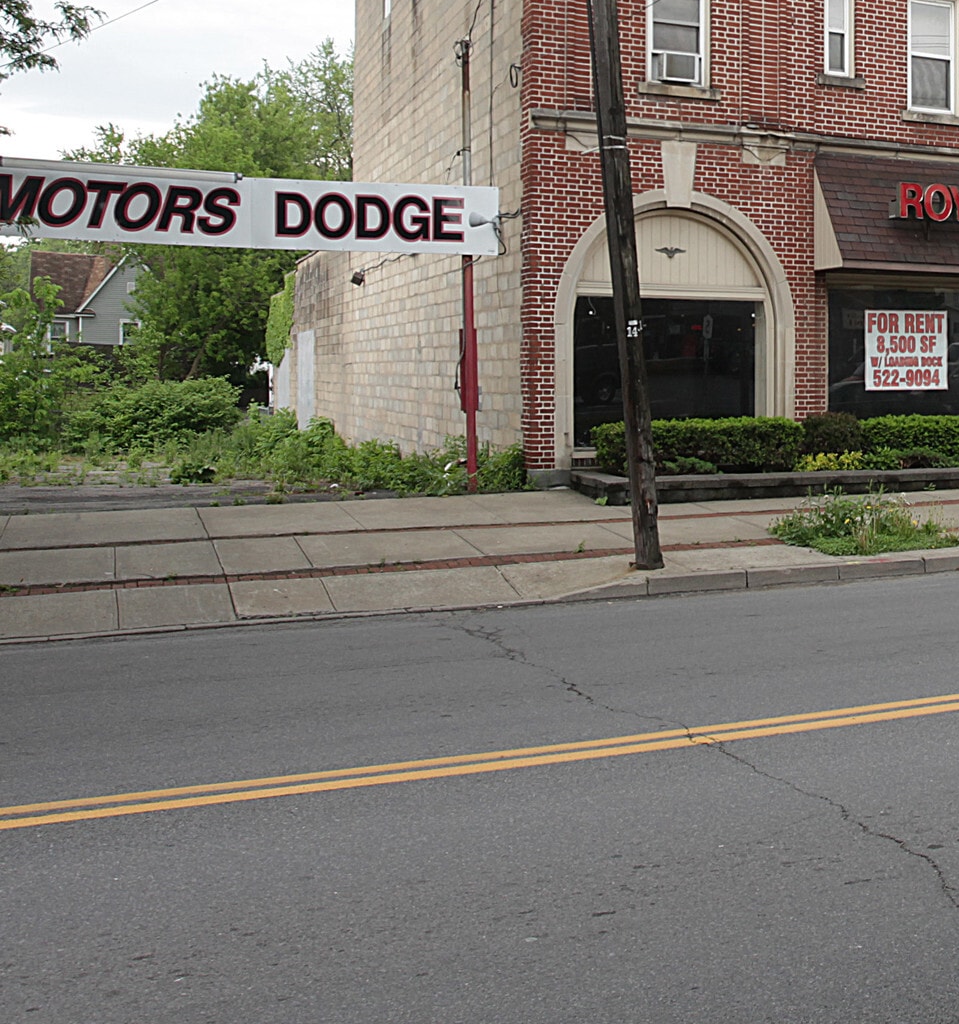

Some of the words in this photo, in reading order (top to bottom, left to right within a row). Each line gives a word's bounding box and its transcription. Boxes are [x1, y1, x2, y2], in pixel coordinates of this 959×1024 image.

[0, 173, 241, 236] MOTORS
[274, 190, 465, 243] DODGE
[626, 326, 638, 338] 14
[867, 312, 899, 333] FOR
[904, 313, 945, 334] RENT
[876, 335, 917, 356] 8,500
[920, 335, 937, 353] SF
[884, 356, 919, 367] LOADING
[921, 356, 943, 367] DOCK
[873, 369, 940, 387] 522-9094
